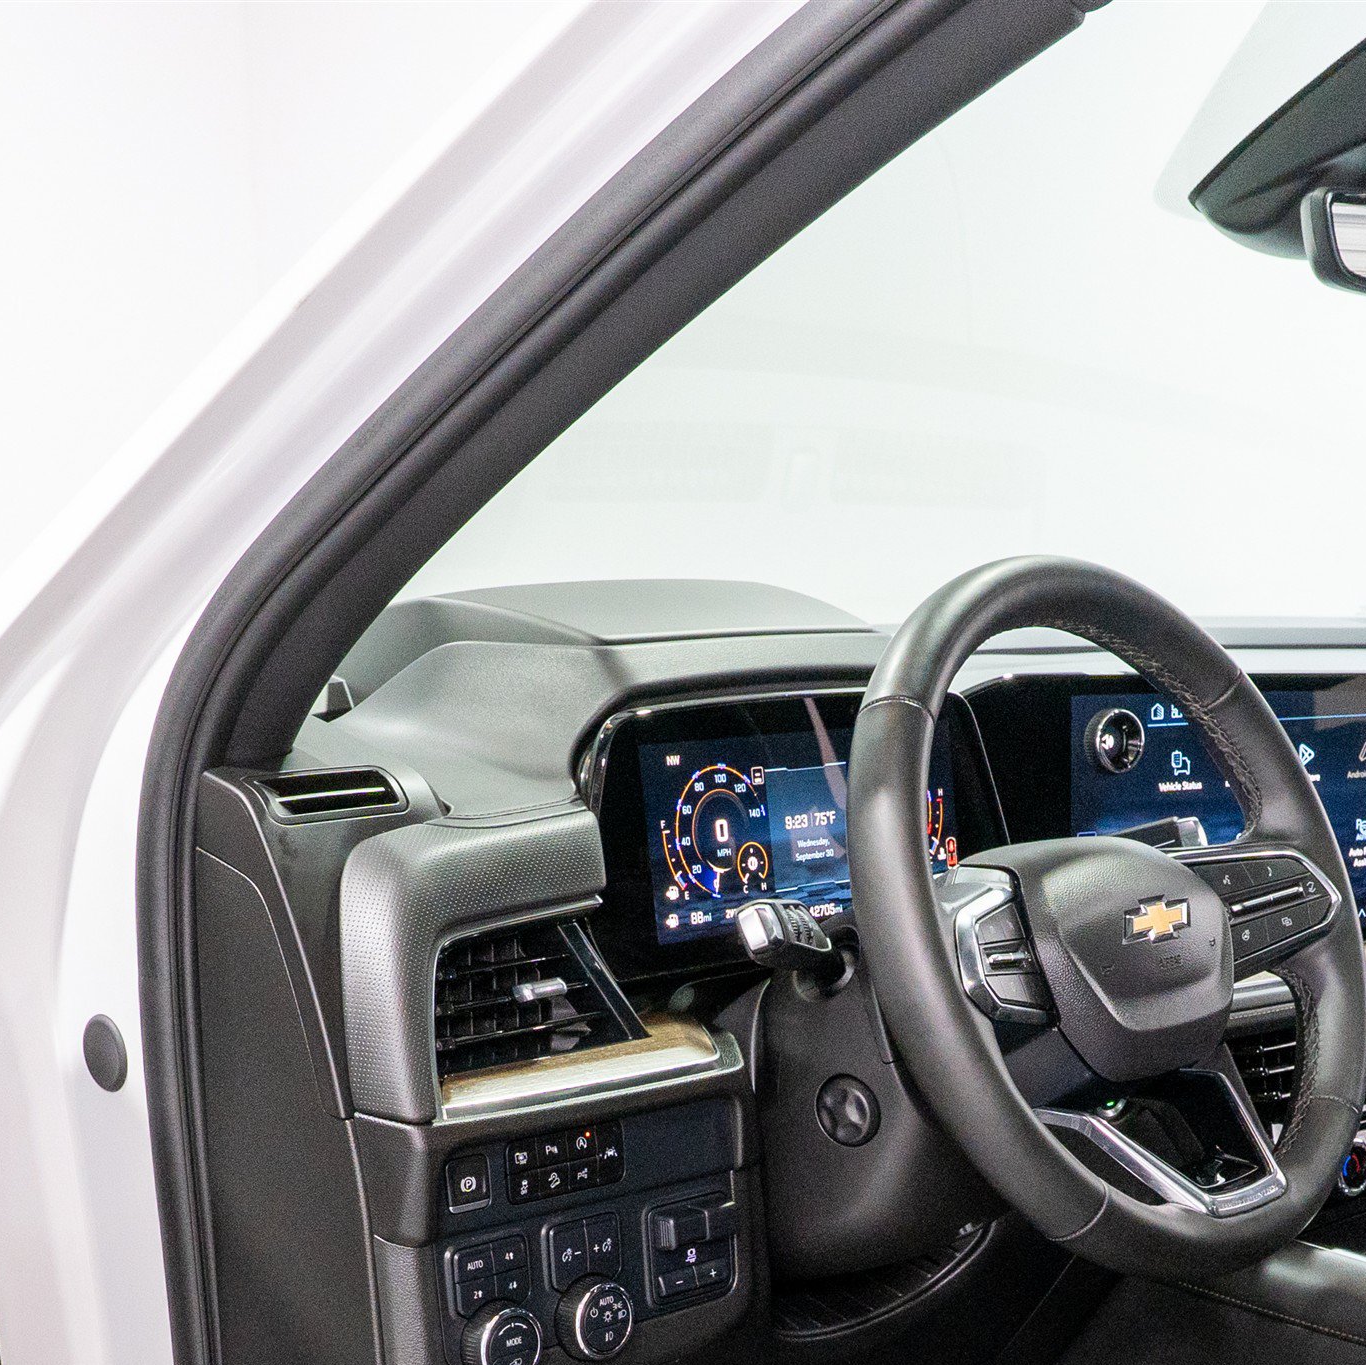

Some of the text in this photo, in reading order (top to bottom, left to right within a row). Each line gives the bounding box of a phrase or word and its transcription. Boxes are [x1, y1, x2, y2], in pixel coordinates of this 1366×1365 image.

[665, 755, 680, 766] NW
[714, 773, 726, 783] 100
[694, 782, 704, 792] 80
[734, 783, 746, 793] 120
[1158, 781, 1202, 792] Vehicle Status
[682, 805, 692, 815] 60
[749, 808, 760, 818] 140
[660, 820, 666, 829] F
[785, 814, 808, 830] 9:23
[714, 818, 729, 842] 0
[681, 837, 691, 846] 40
[797, 837, 830, 848] Wednesday,
[717, 848, 732, 857] MPH
[795, 849, 834, 862] September 30
[692, 864, 702, 874] 20
[743, 885, 749, 894] C
[684, 891, 690, 900] E
[467, 1260, 484, 1271] AUTO
[599, 1296, 614, 1307] AUTO
[506, 1336, 523, 1348] MODE
